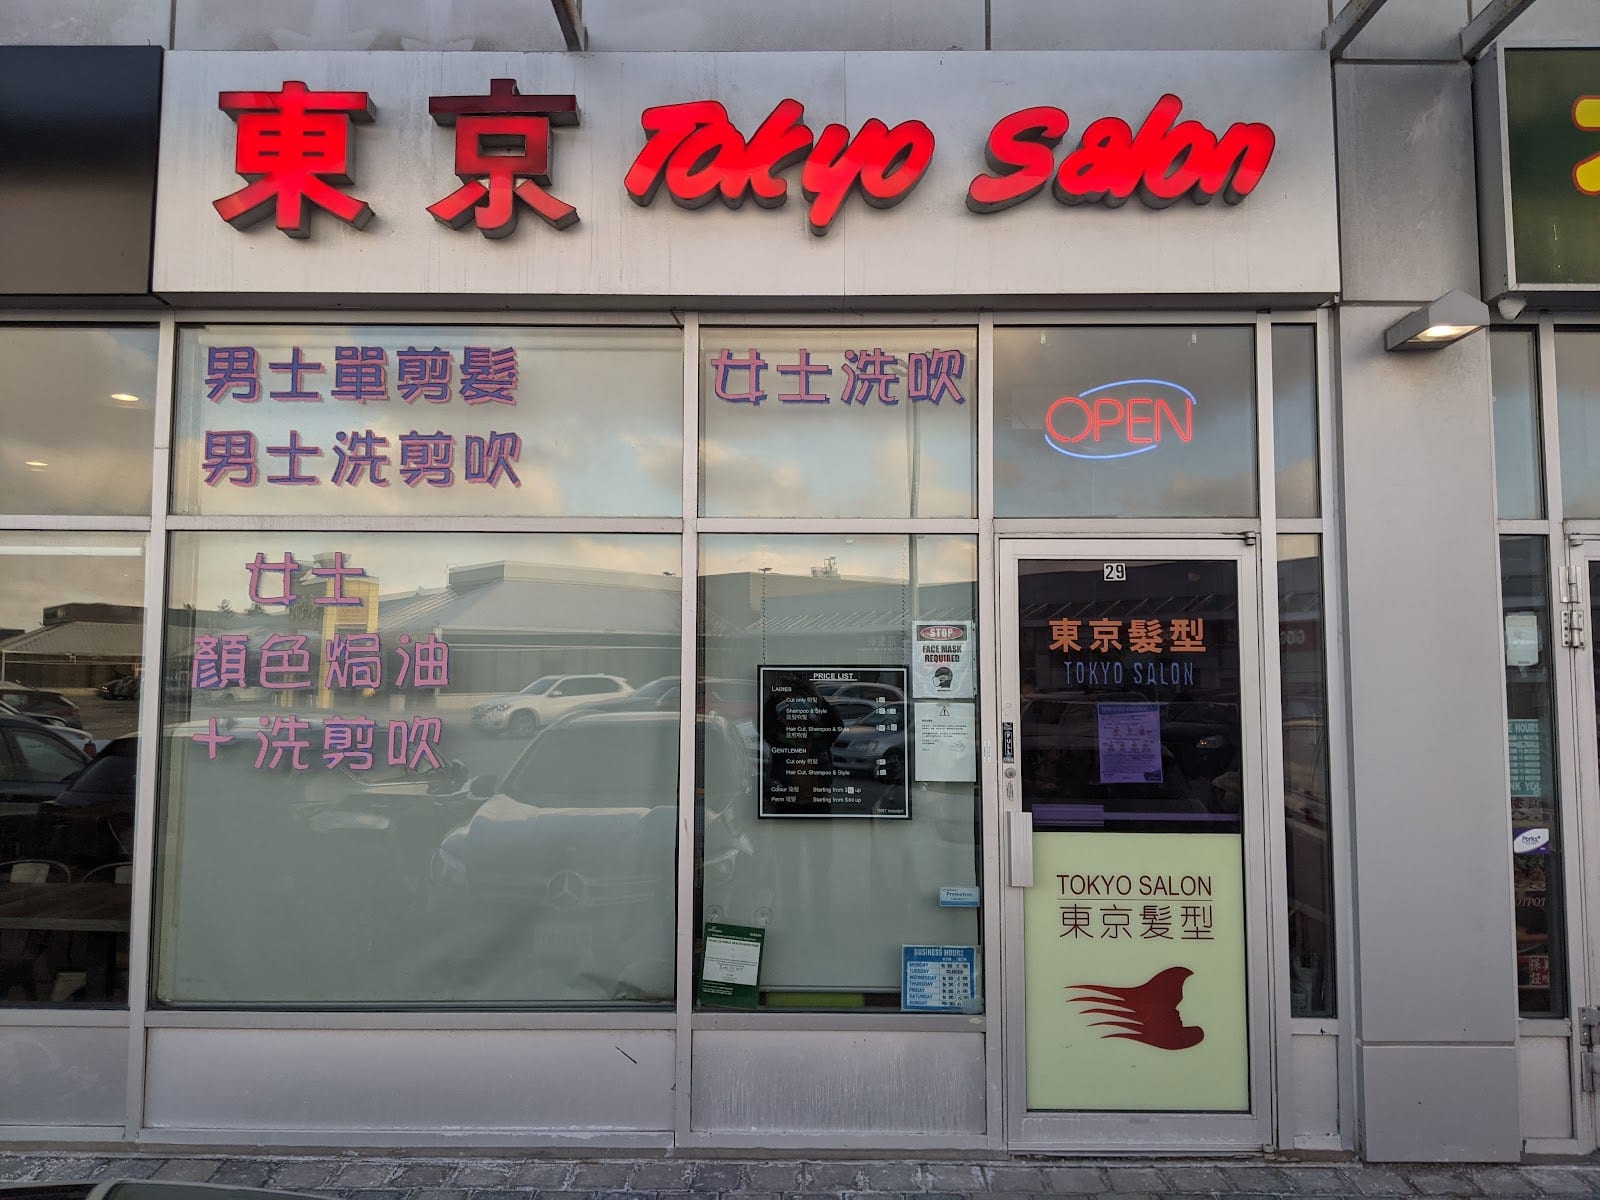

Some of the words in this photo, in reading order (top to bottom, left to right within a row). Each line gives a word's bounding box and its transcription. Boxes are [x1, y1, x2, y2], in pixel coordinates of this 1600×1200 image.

[212, 78, 580, 238] 東京
[624, 98, 935, 236] Tokyo
[204, 346, 521, 406] 男士單剪髮
[711, 348, 965, 405] 女士洗吹
[1046, 396, 1193, 443] OPEN
[202, 430, 522, 487] 男士洗剪吹
[246, 552, 365, 606] 女士
[1105, 564, 1125, 580] 29
[922, 645, 940, 653] FACE
[941, 645, 962, 653] MASK
[929, 627, 954, 638] STOP
[924, 655, 960, 663] REQUIRED
[1063, 661, 1123, 685] TOKYO
[1133, 661, 1194, 686] SALON
[1057, 874, 1132, 895] TOKYO
[1139, 874, 1212, 896] SALON
[913, 948, 943, 957] BUSINESS
[943, 948, 964, 957] HOURS
